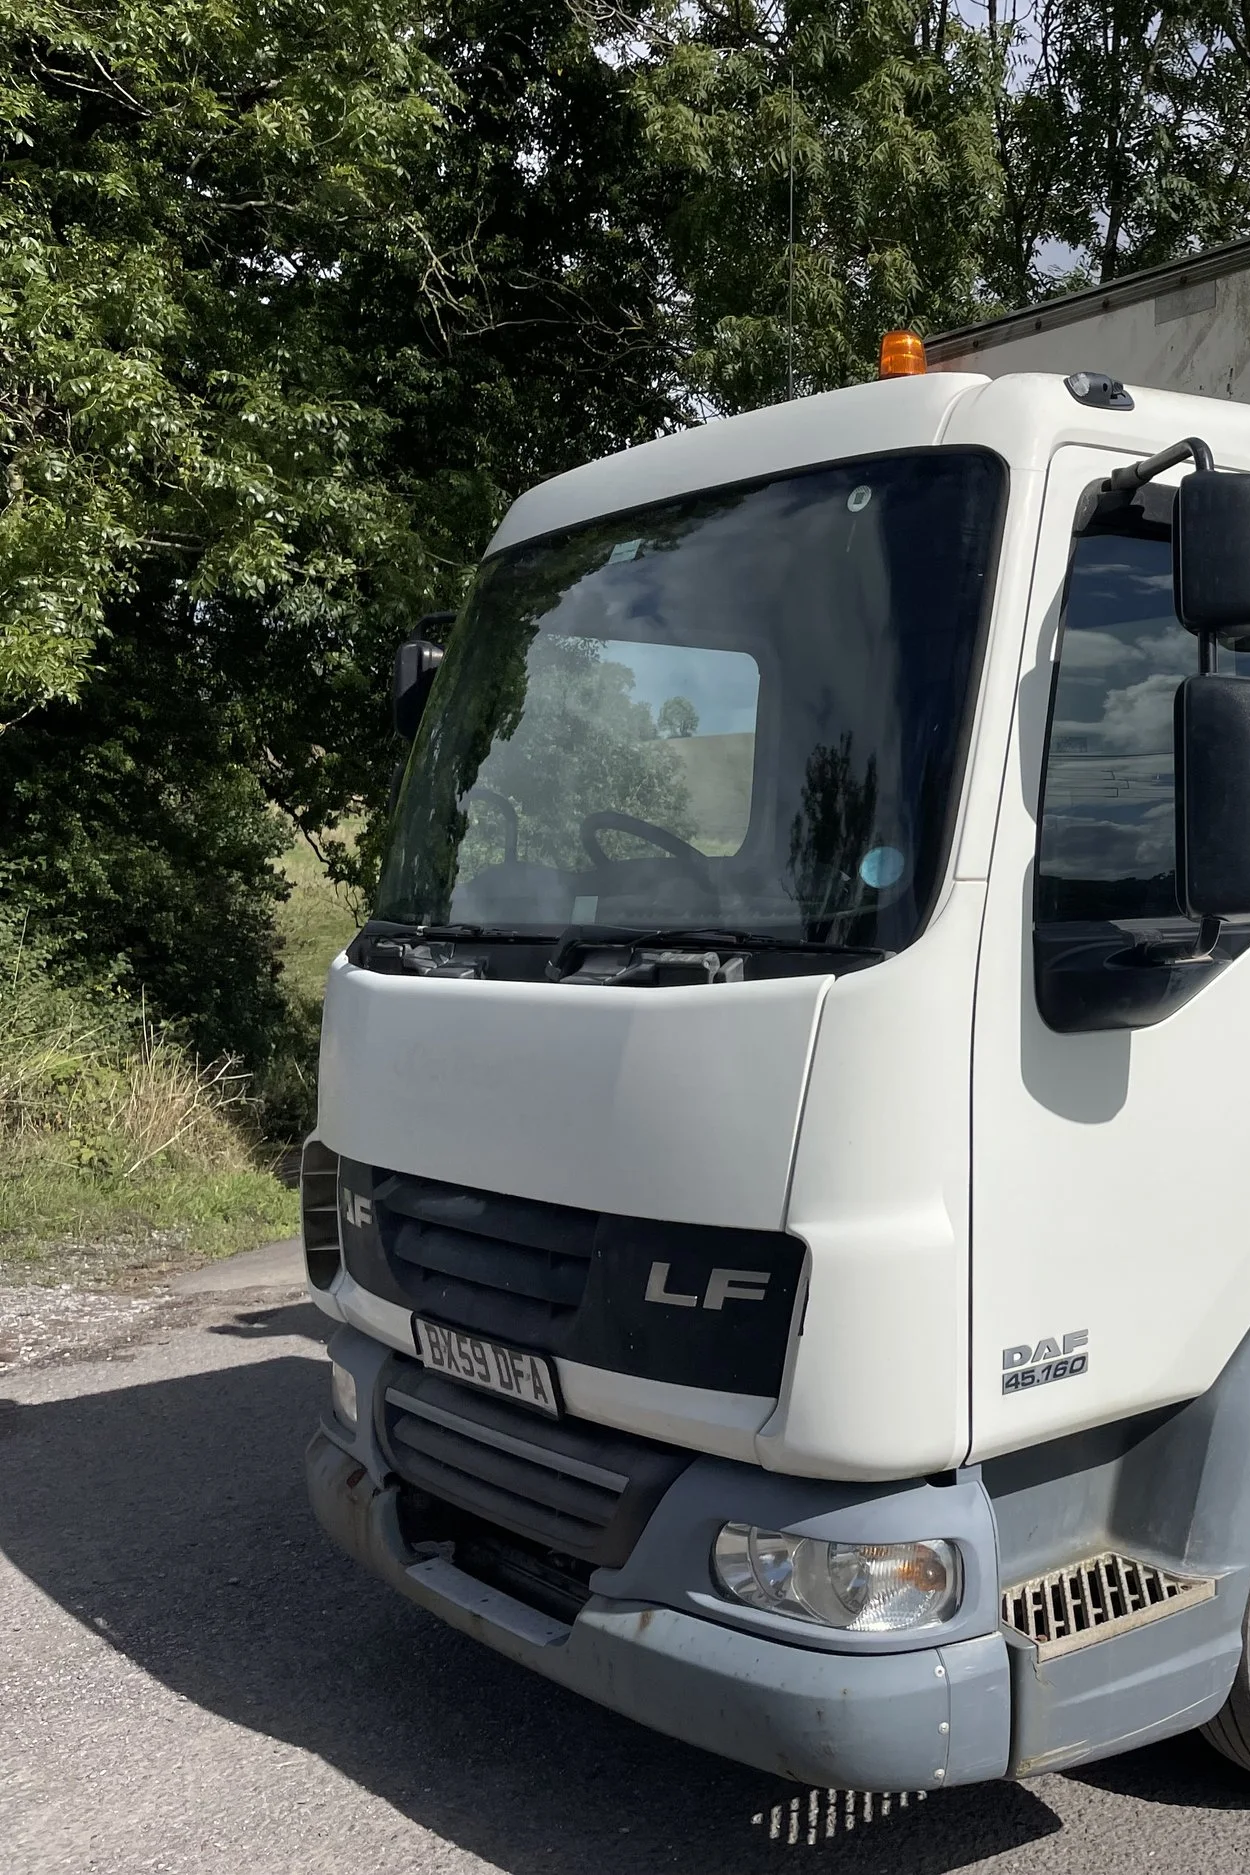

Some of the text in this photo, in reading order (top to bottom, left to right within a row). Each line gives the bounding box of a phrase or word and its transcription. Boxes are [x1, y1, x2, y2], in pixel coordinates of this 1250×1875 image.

[644, 1261, 772, 1311] LF
[423, 1323, 549, 1405] BX59 DFA
[1002, 1328, 1089, 1370] DAF
[1004, 1355, 1087, 1390] 45.160
